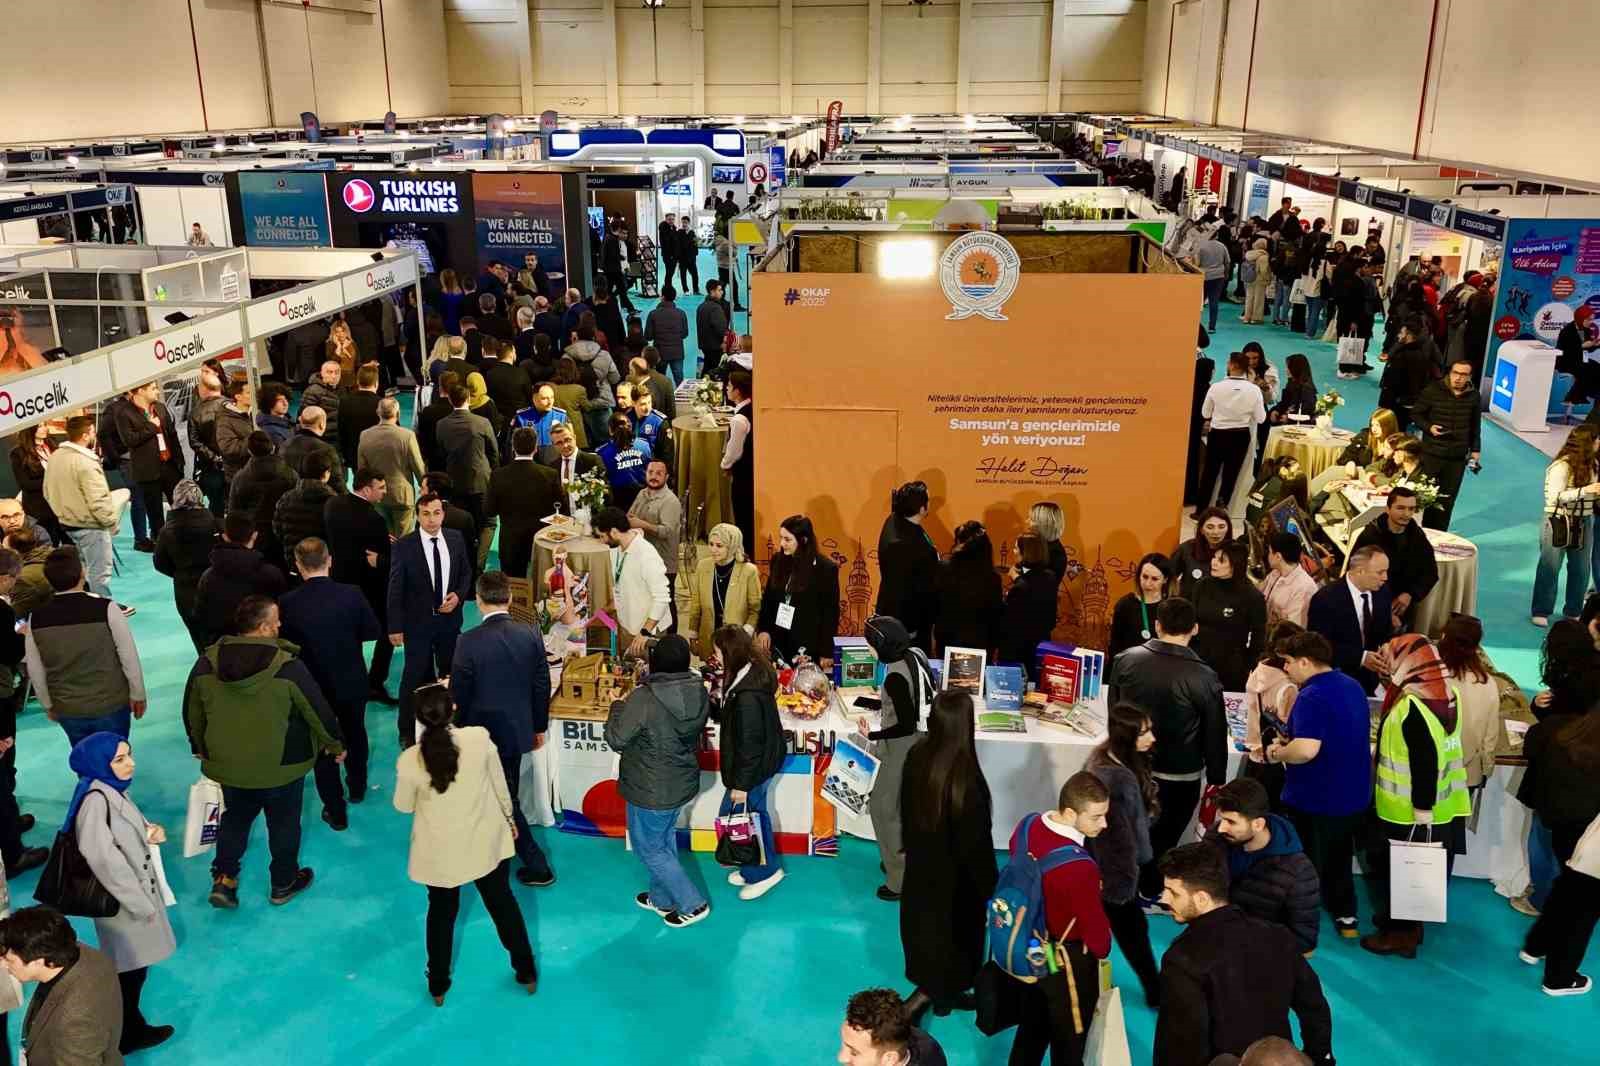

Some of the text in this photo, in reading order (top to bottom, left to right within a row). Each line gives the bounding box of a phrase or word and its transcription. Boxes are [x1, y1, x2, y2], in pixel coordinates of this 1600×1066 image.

[380, 181, 457, 196] TURKISH
[382, 197, 459, 213] AIRLINES
[254, 216, 318, 228] WE ARE ALL
[487, 218, 552, 231] WE ARE ALL
[256, 229, 320, 241] CONNECTED
[488, 232, 553, 244] CONNECTED
[801, 288, 831, 297] OKAF
[801, 297, 825, 305] 2025
[928, 394, 961, 402] Nitelikli
[1041, 395, 1083, 405] yetenekli
[1086, 396, 1148, 405] gençlerimizle
[982, 405, 1005, 413] daha
[1006, 405, 1024, 414] ileri
[949, 418, 1121, 433] Samsun'a gençlerimizle
[981, 432, 1087, 448] yön veriyoruz!
